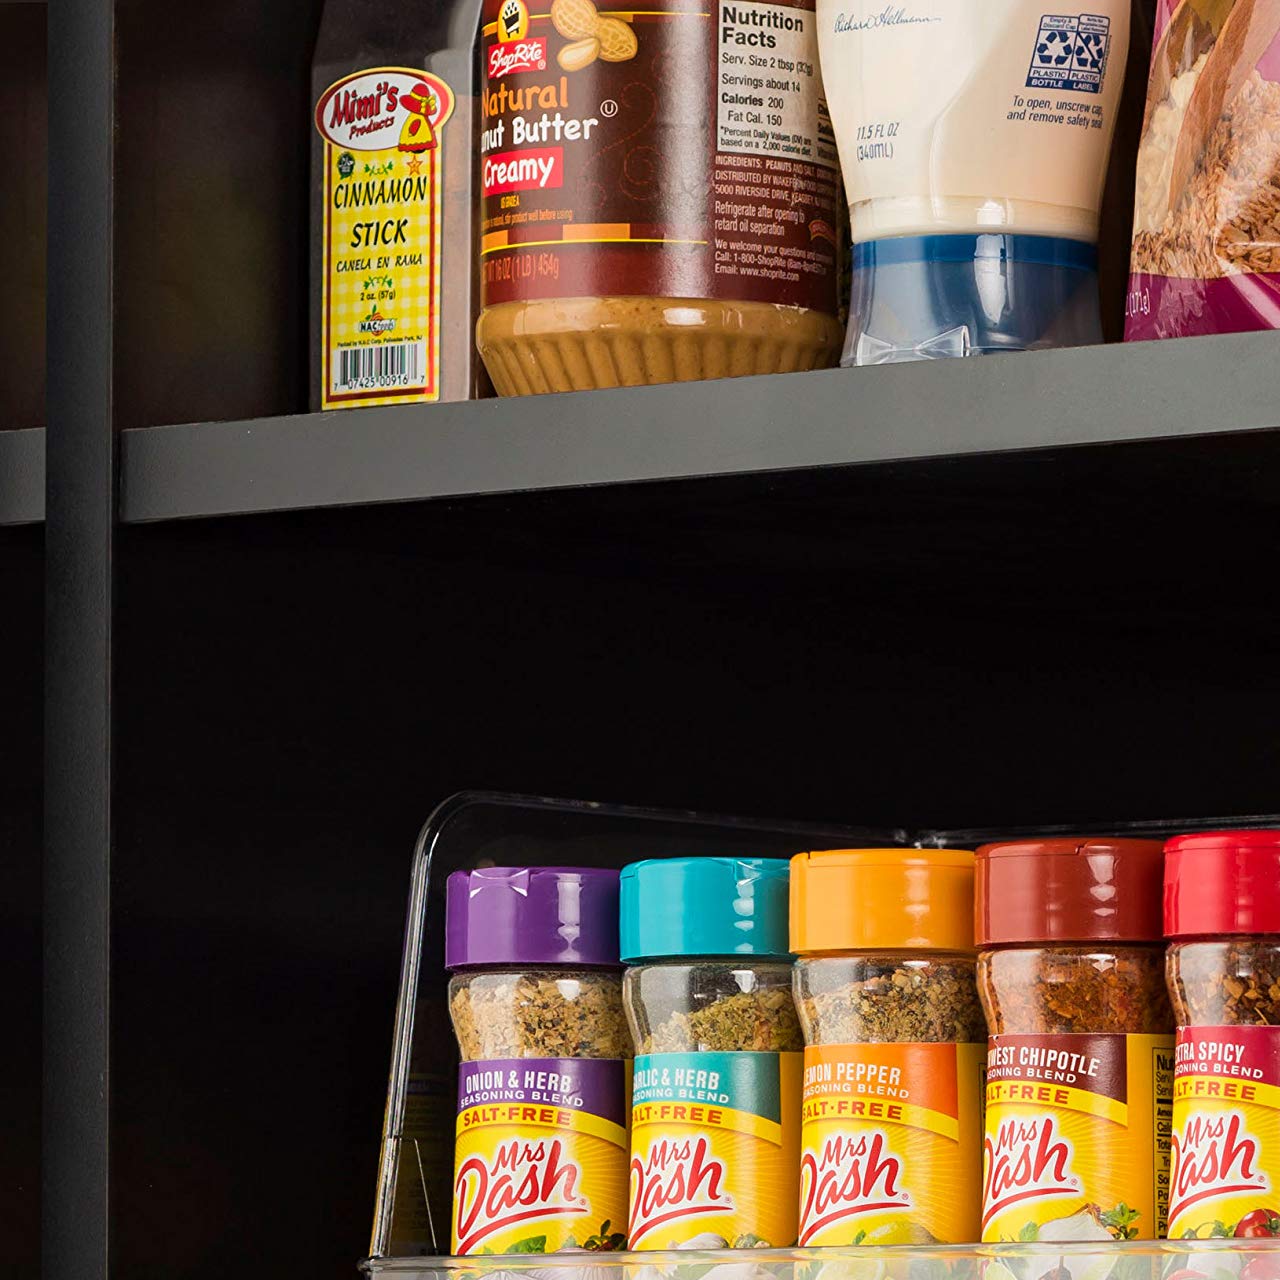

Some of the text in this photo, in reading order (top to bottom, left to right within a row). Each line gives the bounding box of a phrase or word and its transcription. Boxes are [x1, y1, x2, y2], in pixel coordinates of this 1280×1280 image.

[722, 6, 804, 33] Nutrition
[722, 27, 777, 49] Facts
[489, 43, 543, 77] ShopRite
[722, 73, 763, 90] Servings
[1031, 79, 1064, 88] BOTTLE
[1032, 69, 1066, 80] PLASTIC
[329, 82, 400, 129] Mimi's
[482, 76, 569, 119] Natural
[722, 92, 784, 109] Calories 200
[1013, 95, 1091, 114] To unscrew
[512, 112, 599, 145] Butter
[727, 110, 782, 127] Fat 150
[1007, 110, 1090, 129] and remove safety
[856, 122, 900, 141] 11.5 OZ
[483, 156, 555, 188] Creamy
[334, 176, 427, 210] CINNAMON
[350, 219, 409, 248] STICK
[336, 254, 423, 273] CANELA EN RAMA
[347, 374, 408, 390] 07425 00916
[1020, 1046, 1101, 1077] CHIPOTLE
[1199, 1042, 1245, 1064] SPICY
[465, 1070, 573, 1093] ONION & HERB
[674, 1068, 720, 1090] HERB
[836, 1062, 902, 1086] PEPPER
[1026, 1067, 1077, 1084] BLEND
[1213, 1062, 1264, 1080] BLEND
[460, 1089, 584, 1109] SEASONING BLEND
[678, 1088, 730, 1104] BLEND
[857, 1083, 910, 1099] BLEND
[999, 1117, 1038, 1153] Mrs
[1182, 1115, 1225, 1152] Mrs
[491, 1140, 545, 1176] Mrs
[646, 1140, 691, 1176] Mrs
[820, 1135, 867, 1172] Mrs
[456, 1140, 578, 1240] Dash
